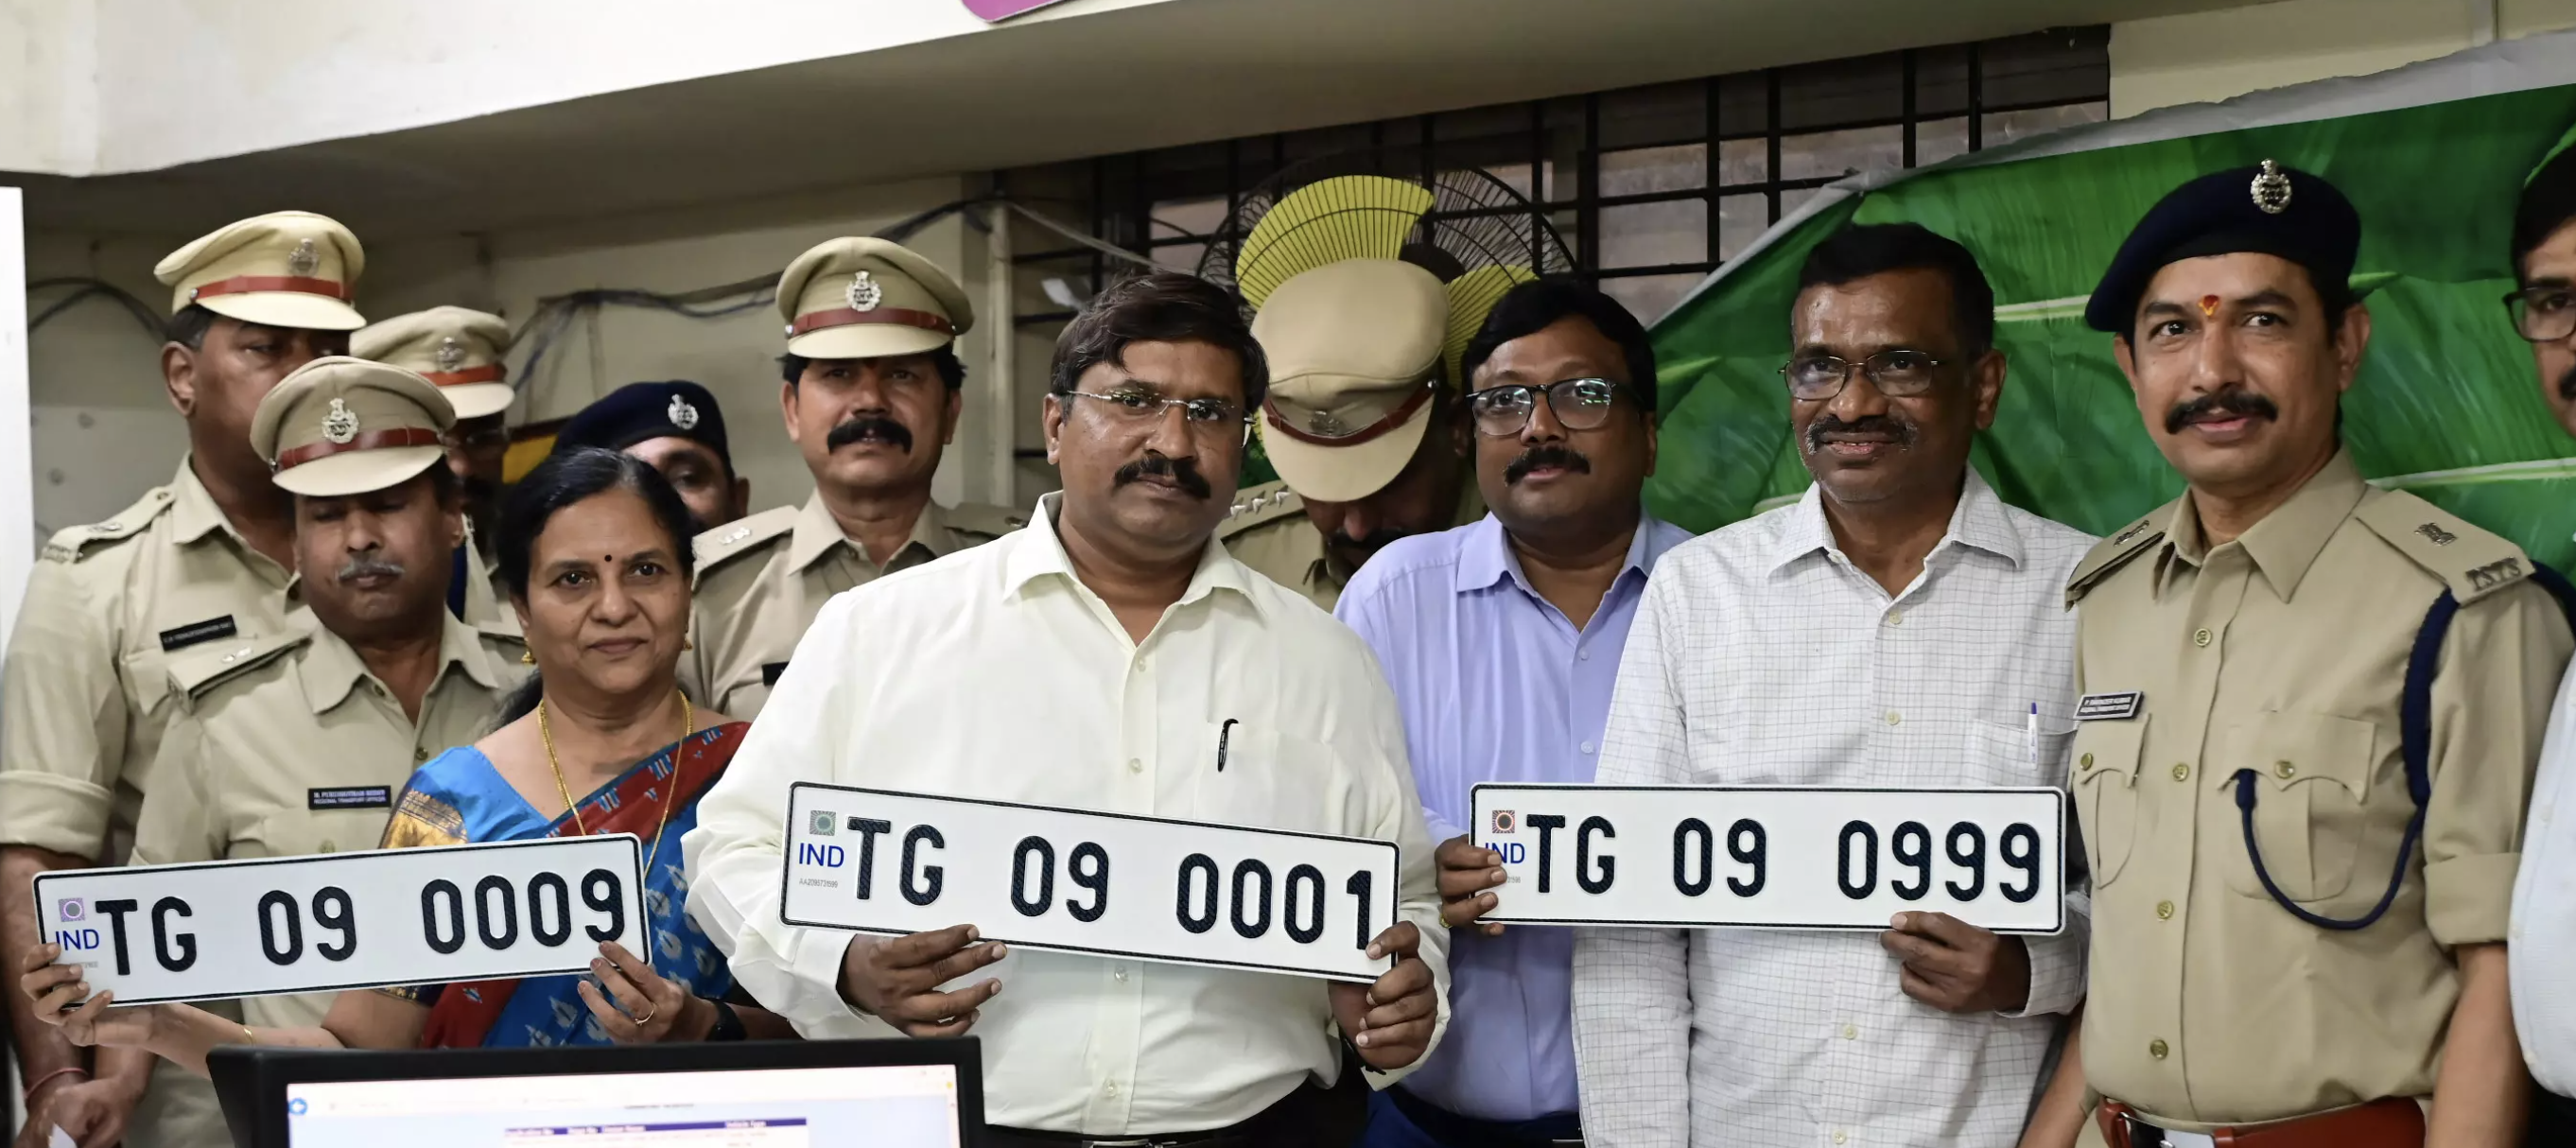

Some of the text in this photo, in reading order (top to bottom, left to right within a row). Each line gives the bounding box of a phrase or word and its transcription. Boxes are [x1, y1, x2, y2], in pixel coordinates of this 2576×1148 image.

[798, 842, 844, 868] IND
[846, 817, 1371, 950] TG 09 0001
[1485, 842, 1525, 864] ND
[1526, 813, 2041, 903] TG 09 0999
[95, 868, 625, 976] TG 09 0009
